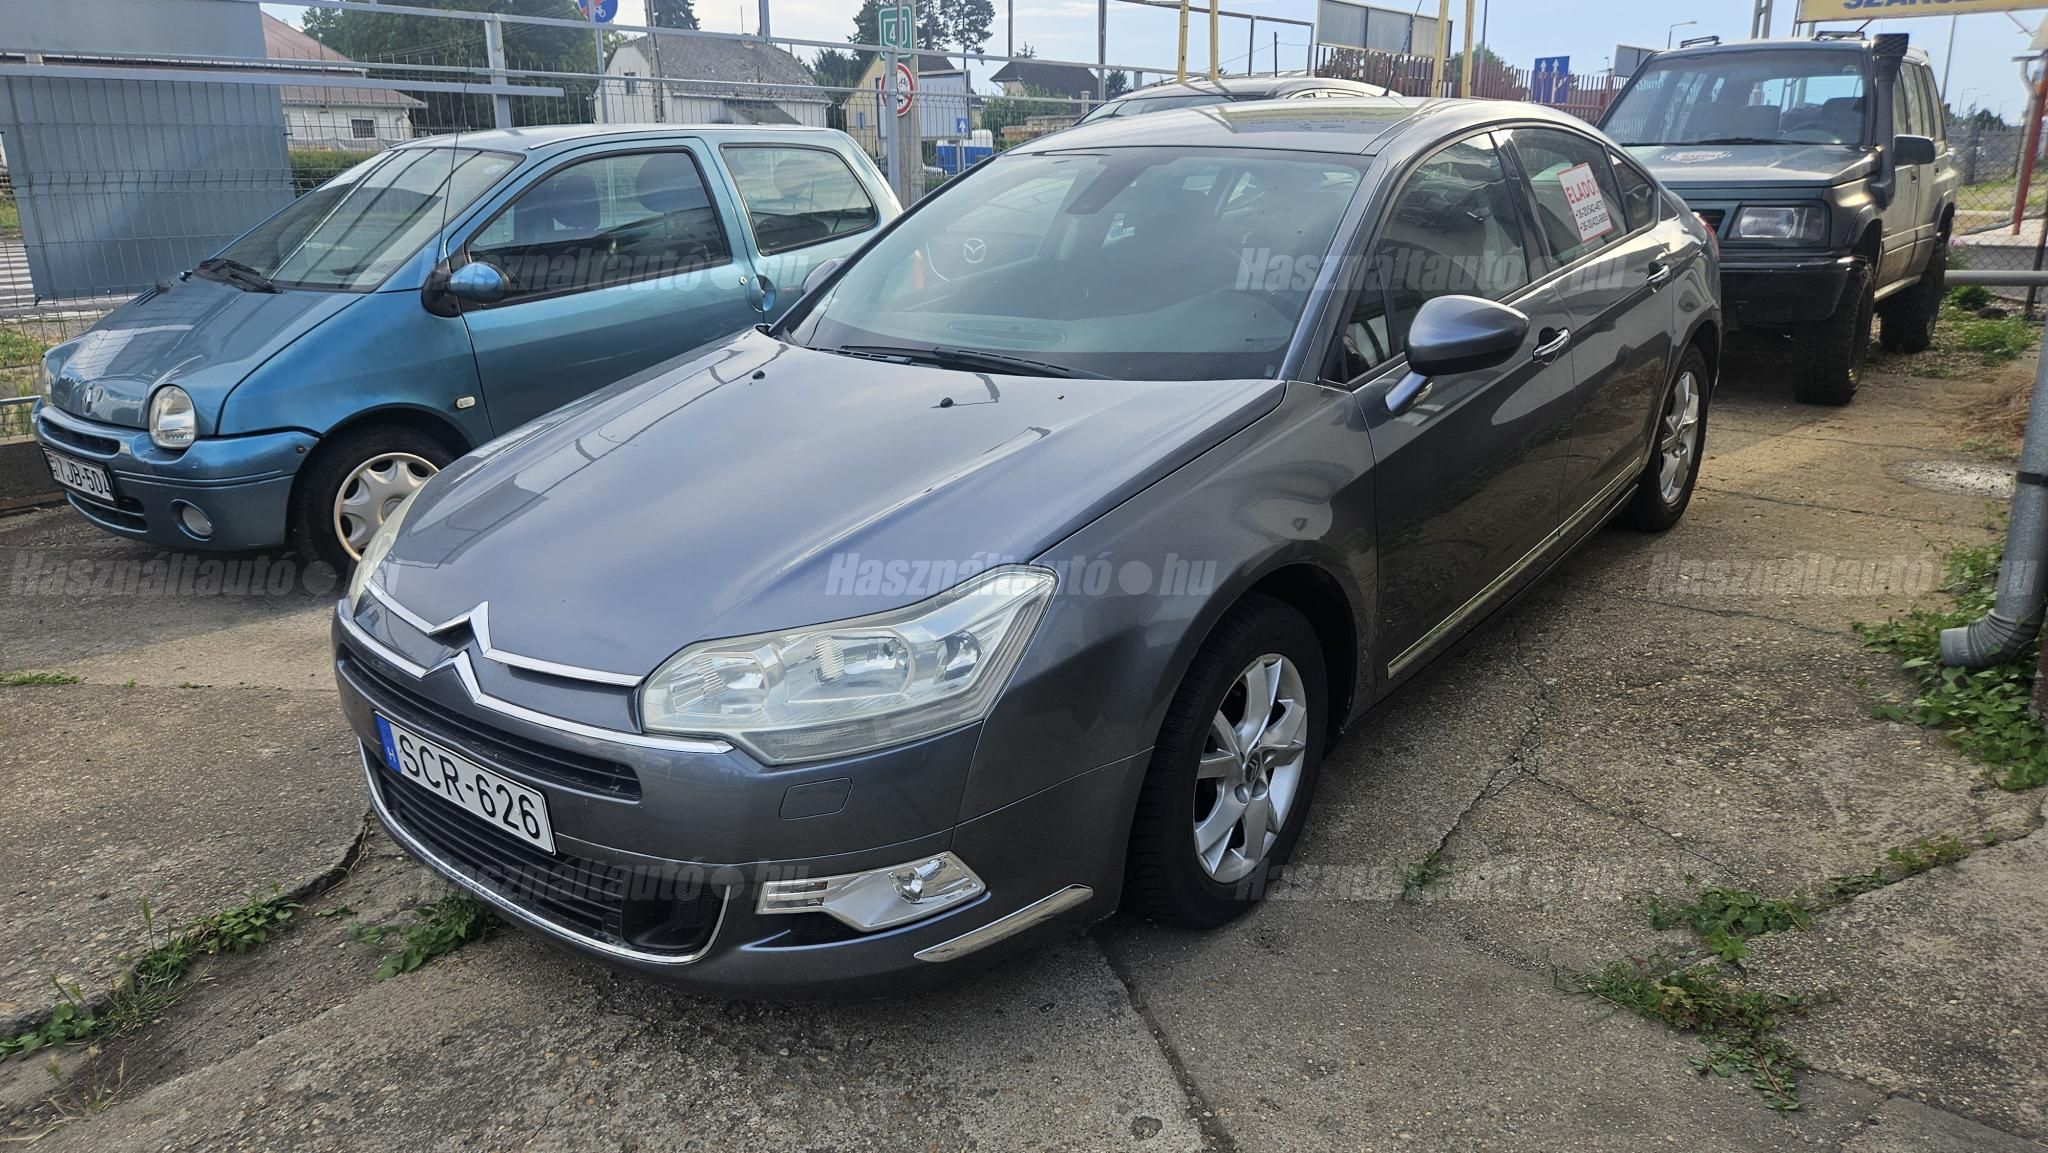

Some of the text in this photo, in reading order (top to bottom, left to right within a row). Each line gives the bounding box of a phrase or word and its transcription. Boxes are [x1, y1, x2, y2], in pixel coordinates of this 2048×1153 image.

[889, 23, 897, 42] 4
[387, 746, 396, 763] H
[399, 734, 541, 840] SCR-626
